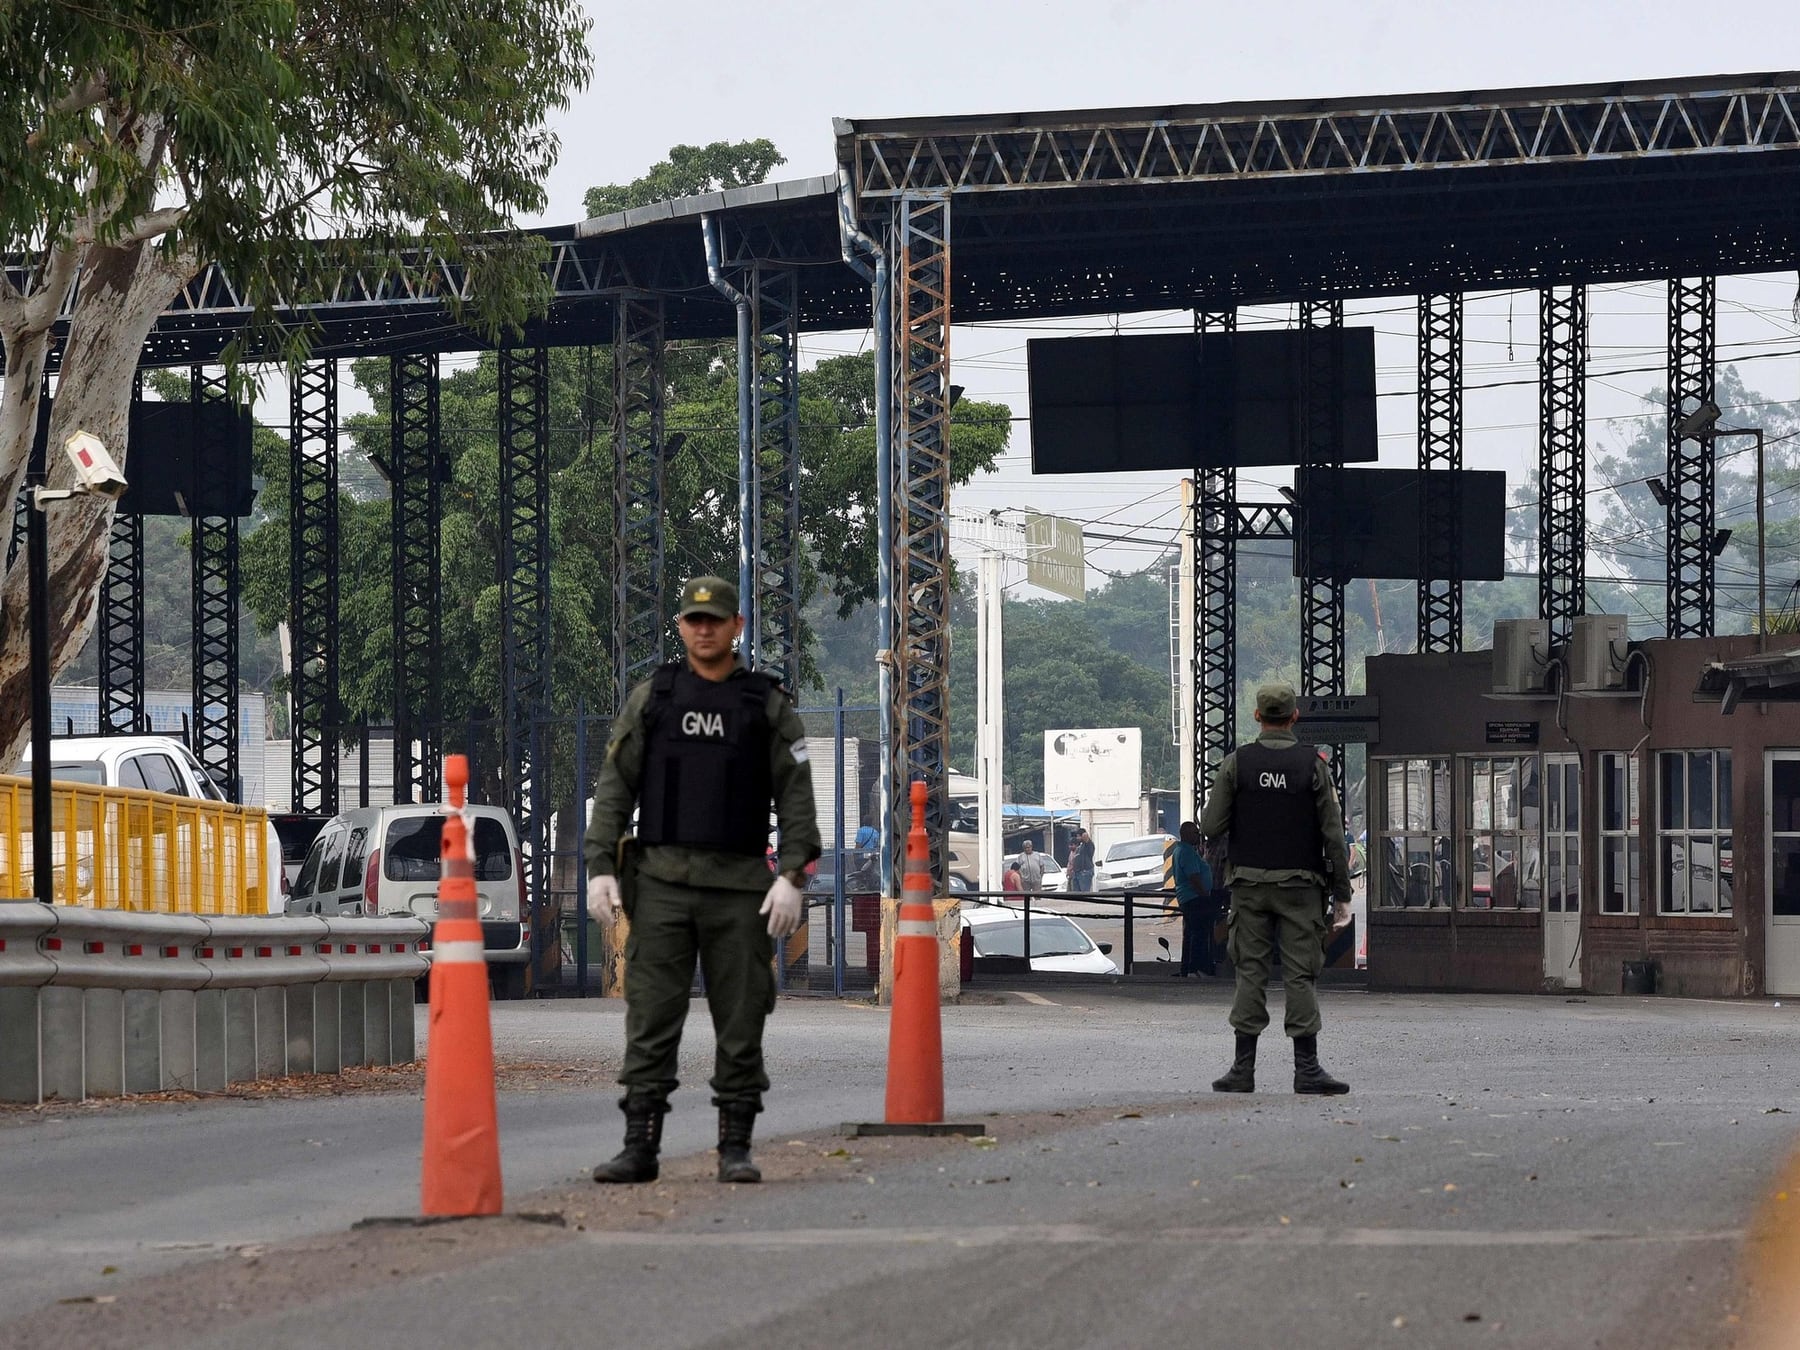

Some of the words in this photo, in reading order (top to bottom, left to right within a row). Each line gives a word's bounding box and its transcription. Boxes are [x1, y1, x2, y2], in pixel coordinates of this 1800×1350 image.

[1041, 524, 1082, 557] CLRINDA
[682, 711, 724, 737] GNA
[1259, 771, 1287, 789] GNA
